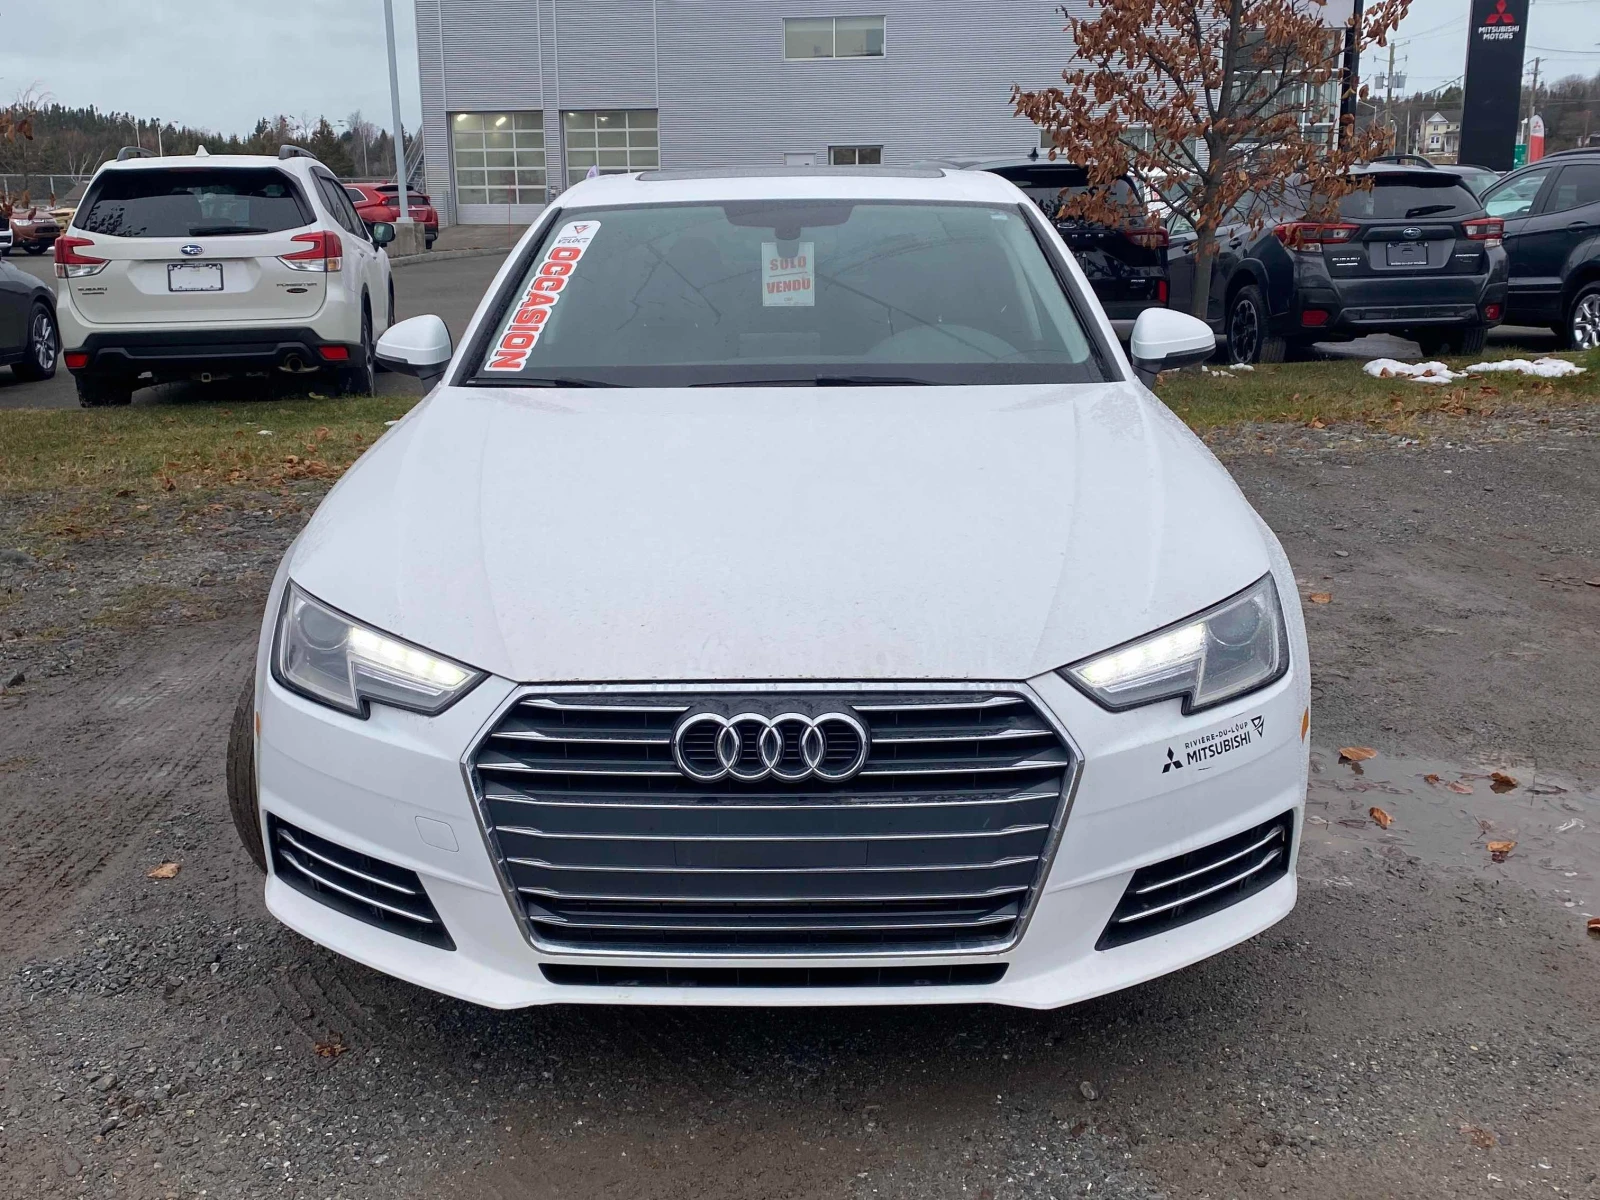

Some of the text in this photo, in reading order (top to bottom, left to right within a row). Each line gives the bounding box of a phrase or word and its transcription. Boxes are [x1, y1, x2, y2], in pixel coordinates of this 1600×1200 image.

[1478, 25, 1520, 33] MITSUBISHI
[1483, 32, 1514, 40] MOTORS
[766, 278, 811, 294] VENDU
[489, 246, 582, 369] OCCASION
[1186, 731, 1251, 765] MITSUBISHI
